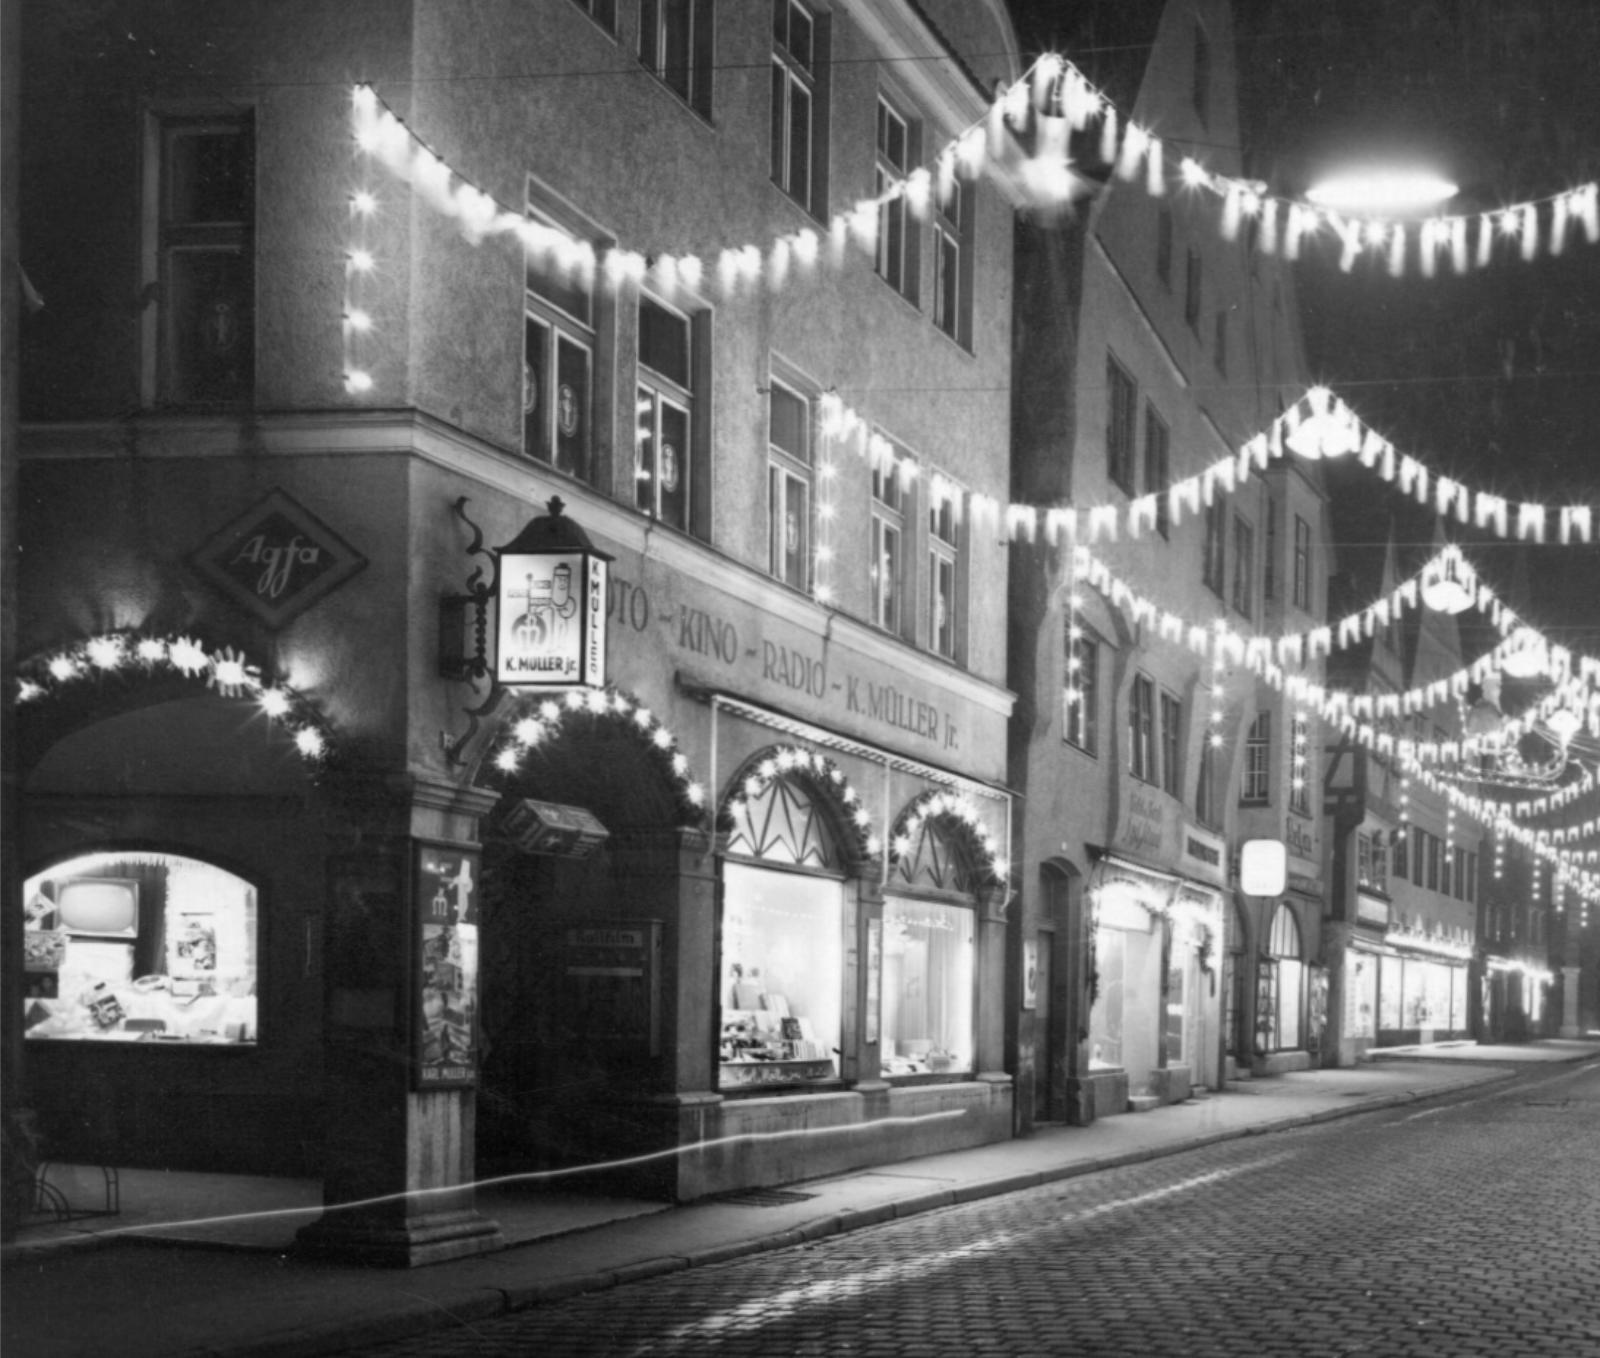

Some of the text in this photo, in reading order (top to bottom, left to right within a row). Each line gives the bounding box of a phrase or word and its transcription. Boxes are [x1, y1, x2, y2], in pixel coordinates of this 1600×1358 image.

[229, 534, 320, 599] Agfa
[679, 605, 738, 665] KINO
[763, 641, 827, 699] RADIO
